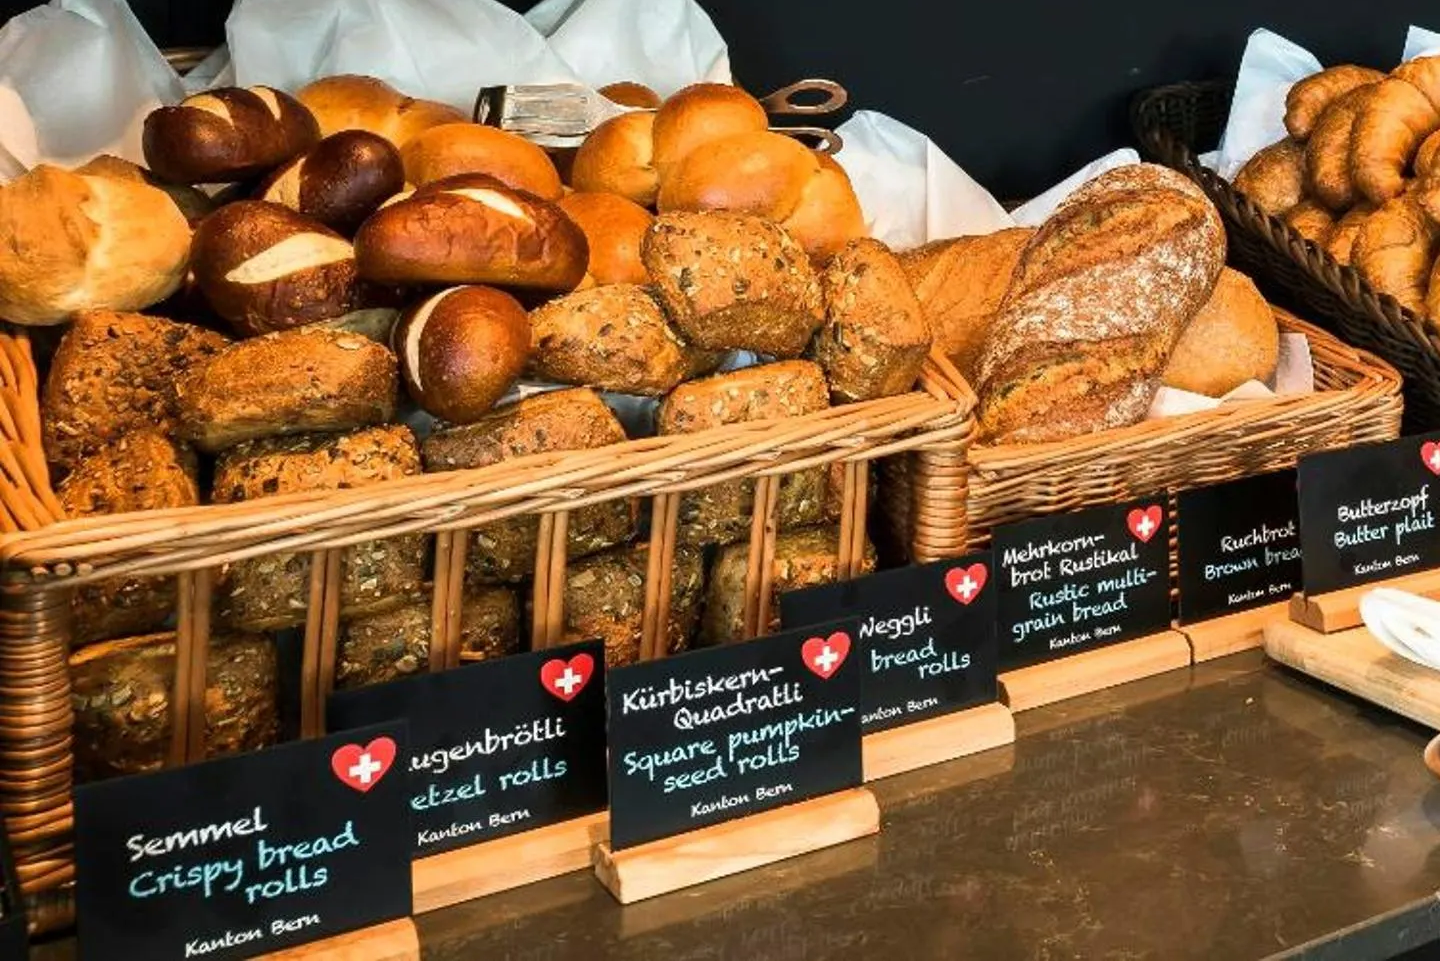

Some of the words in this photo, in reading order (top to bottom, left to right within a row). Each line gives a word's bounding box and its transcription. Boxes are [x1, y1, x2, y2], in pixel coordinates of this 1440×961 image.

[1337, 484, 1430, 523] Butterzopf
[1220, 520, 1297, 554] Ruchbrot
[1333, 524, 1390, 549] Butter
[1394, 510, 1436, 546] plait
[1001, 533, 1106, 568] Mehrkorn-
[1010, 561, 1052, 588] brot
[1058, 542, 1140, 577] Rustikal
[1204, 554, 1260, 582] Brown
[1264, 545, 1302, 566] brea
[1353, 560, 1393, 577] Kanton
[1028, 576, 1091, 611] Rustic
[1096, 566, 1159, 595] multi-
[1227, 588, 1266, 607] Kanton
[1010, 611, 1066, 643] grain
[1072, 592, 1129, 623] bread
[870, 637, 938, 673] bread
[1048, 629, 1093, 651] Kanton
[917, 651, 971, 680] rolls
[622, 665, 785, 715] Kürbiskern-
[672, 682, 804, 730] Quadratli
[860, 706, 903, 725] anton
[906, 696, 939, 713] Bern
[407, 716, 568, 774] ugenbrötli
[623, 738, 717, 782] Square
[728, 706, 856, 763] pumpkin-
[409, 773, 487, 811] etzel
[498, 757, 569, 791] rolls
[662, 755, 729, 794] seed
[736, 742, 801, 776] rolls
[690, 793, 750, 819] Kanton
[755, 782, 794, 801] Bern
[124, 805, 270, 862] Semmel
[416, 819, 483, 846] Kanton
[488, 806, 532, 828] Bern
[128, 857, 244, 899] Crispy
[257, 820, 361, 871] bread
[243, 863, 329, 905] rolls
[184, 926, 264, 960] Kanton
[270, 911, 323, 937] Bern
